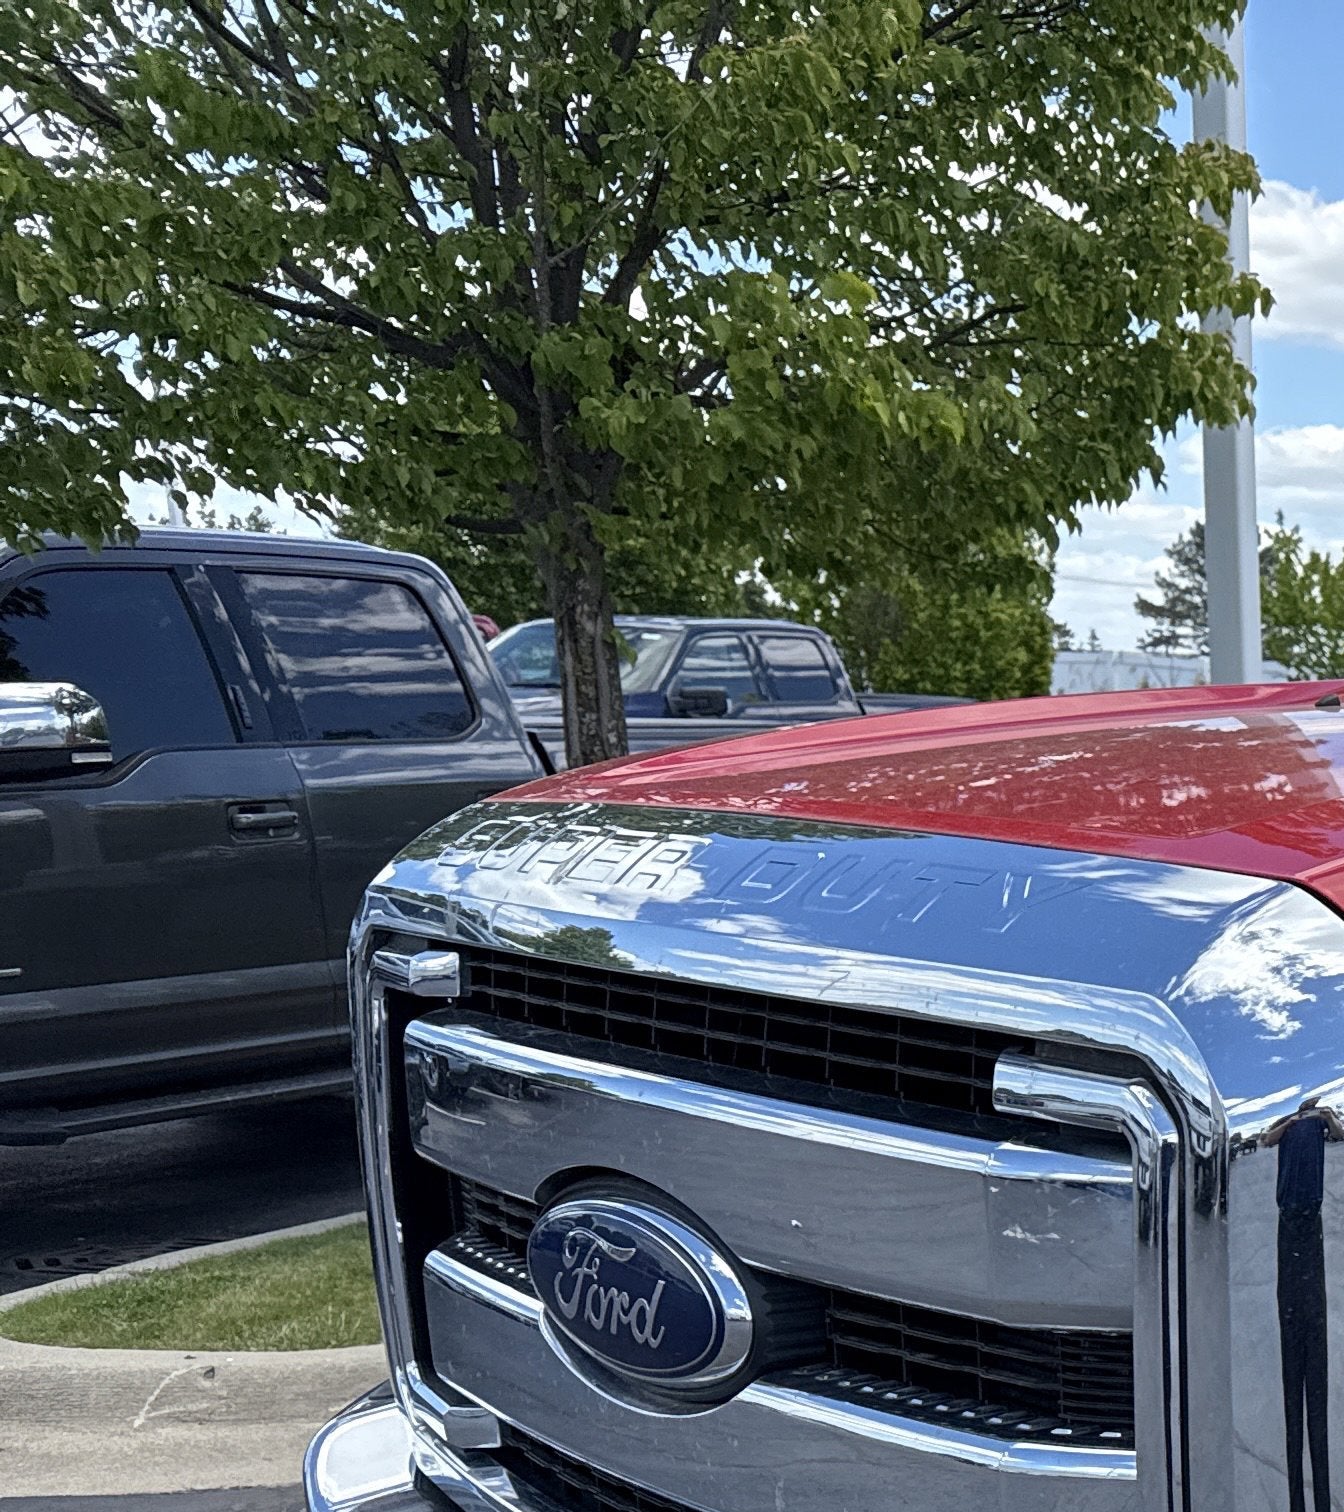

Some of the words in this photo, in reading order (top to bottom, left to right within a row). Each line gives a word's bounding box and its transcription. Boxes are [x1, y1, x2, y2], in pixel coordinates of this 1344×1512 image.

[436, 816, 712, 892] SUPER
[711, 847, 1095, 933] DUTY
[554, 1228, 665, 1349] Ford
